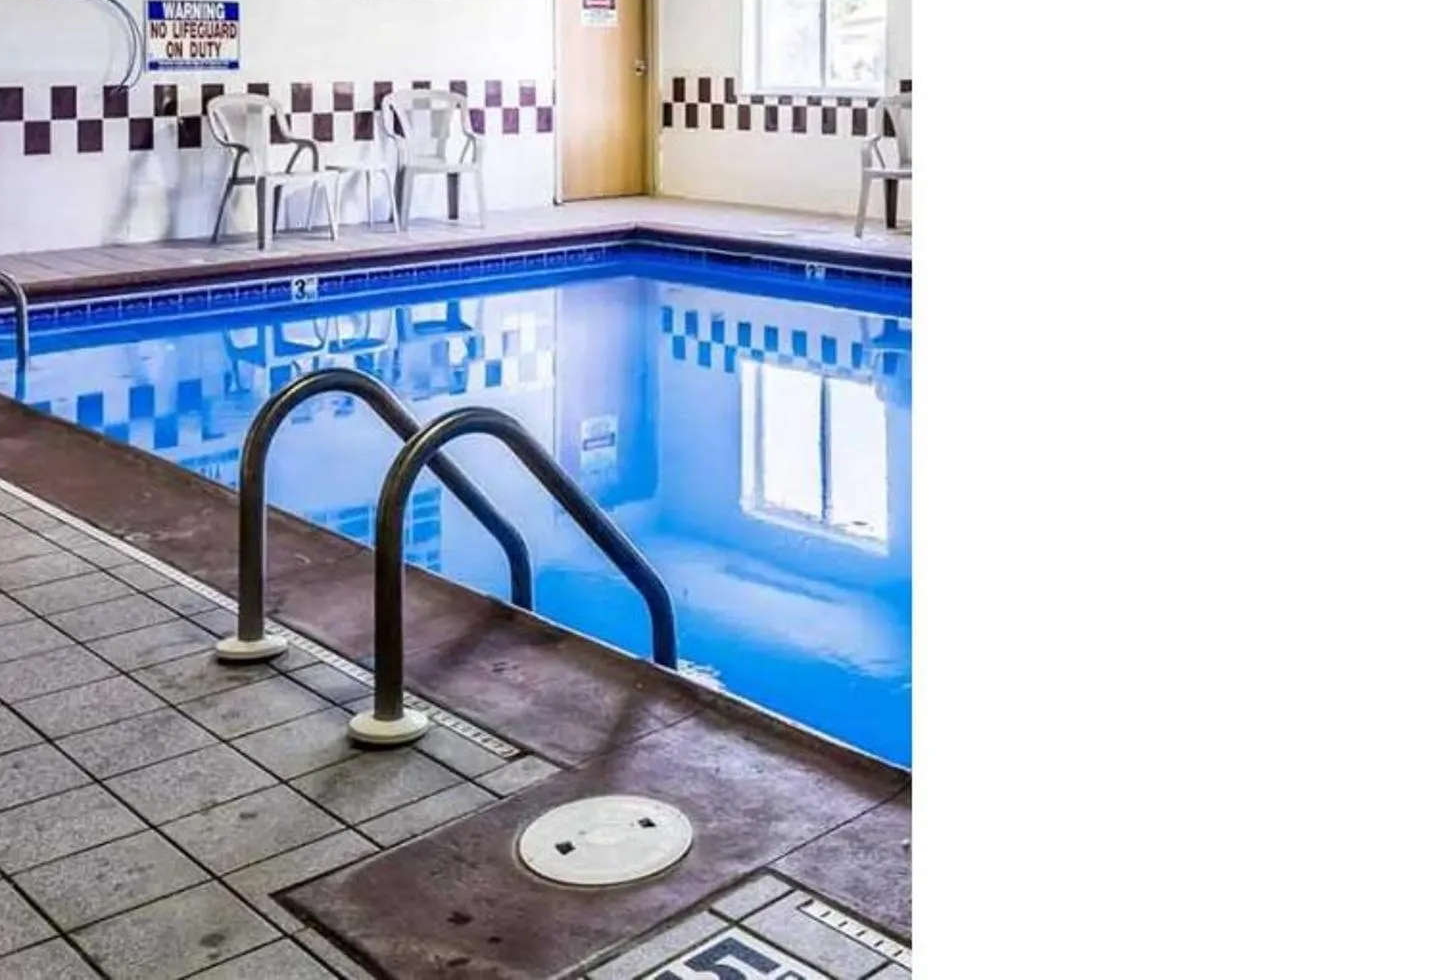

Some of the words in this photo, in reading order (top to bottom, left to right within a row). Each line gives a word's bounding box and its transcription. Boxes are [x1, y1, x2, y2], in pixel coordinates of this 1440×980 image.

[162, 2, 225, 19] WARNING
[150, 21, 167, 38] NO
[173, 21, 237, 38] LIFEGUARD
[166, 40, 183, 57] ON
[189, 41, 221, 58] DUTY
